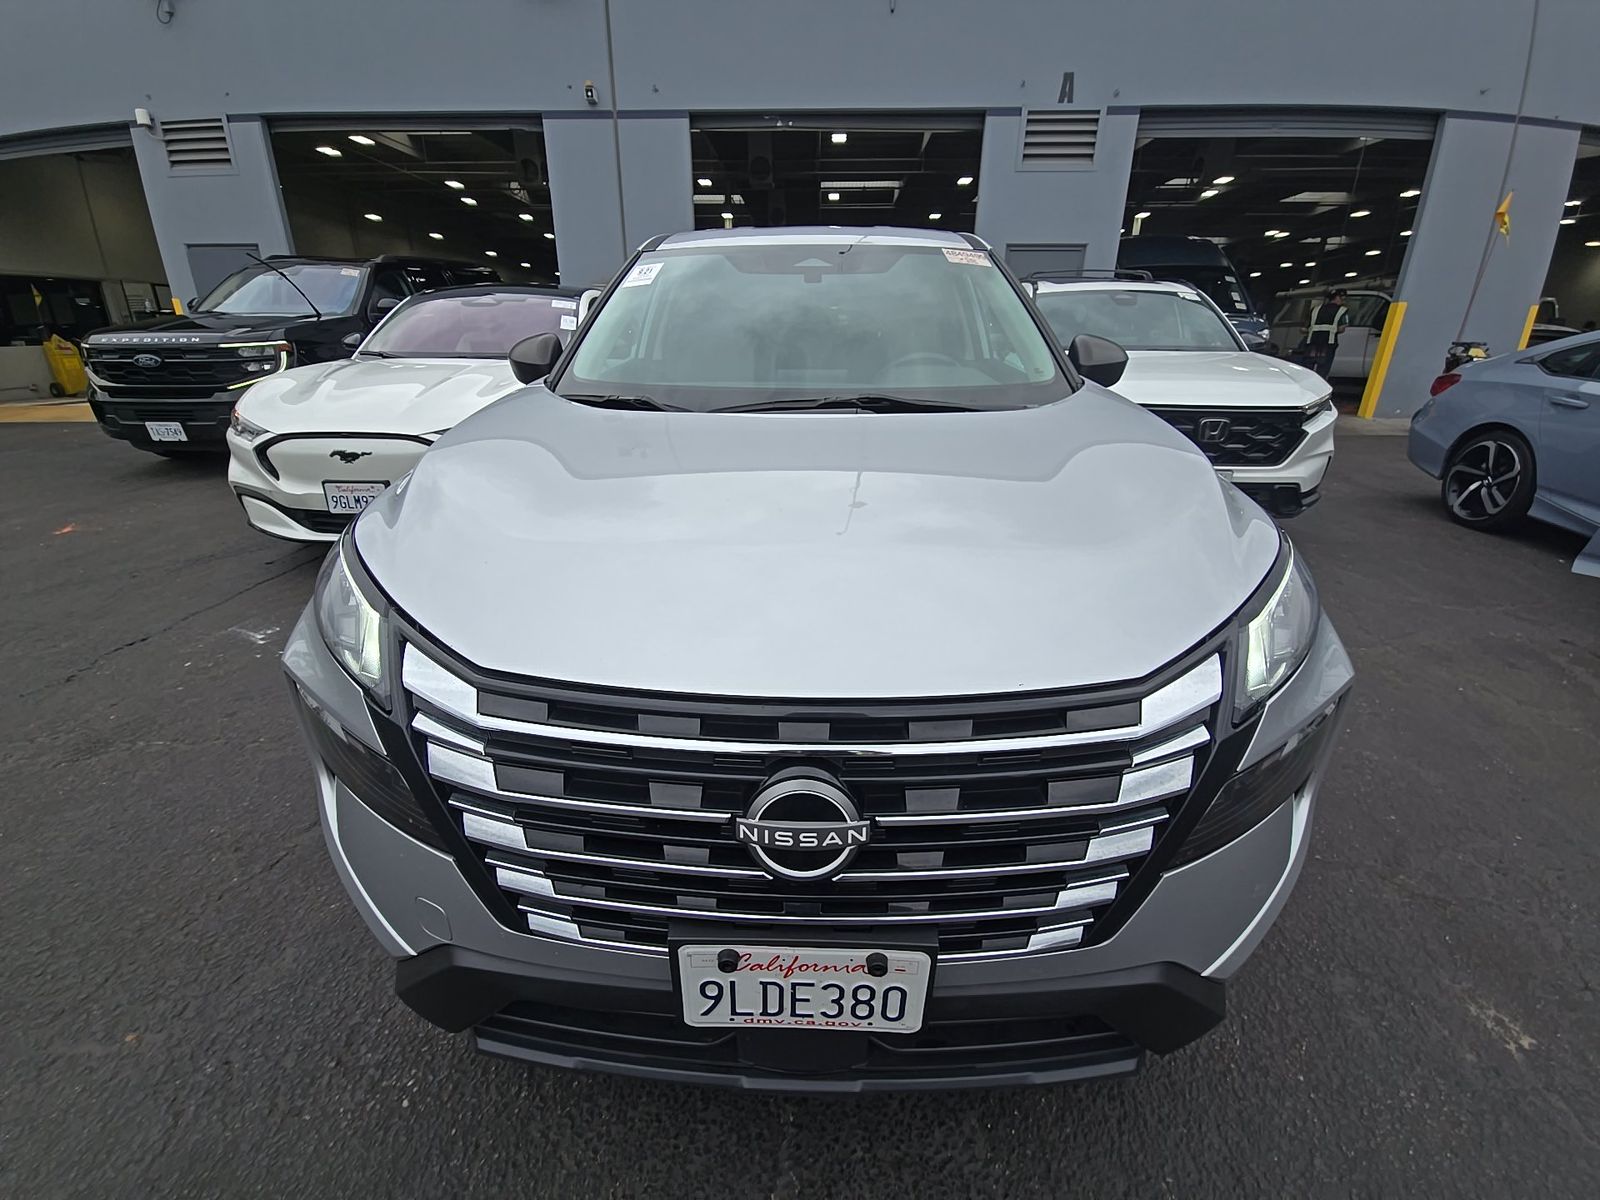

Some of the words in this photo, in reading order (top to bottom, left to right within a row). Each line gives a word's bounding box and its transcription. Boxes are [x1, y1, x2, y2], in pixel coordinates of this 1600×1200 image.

[1057, 71, 1075, 104] A
[739, 824, 868, 847] NISSAN
[735, 952, 869, 978] California
[699, 980, 908, 1022] 9LDE380
[743, 1017, 863, 1027] dmv.ca.gov
